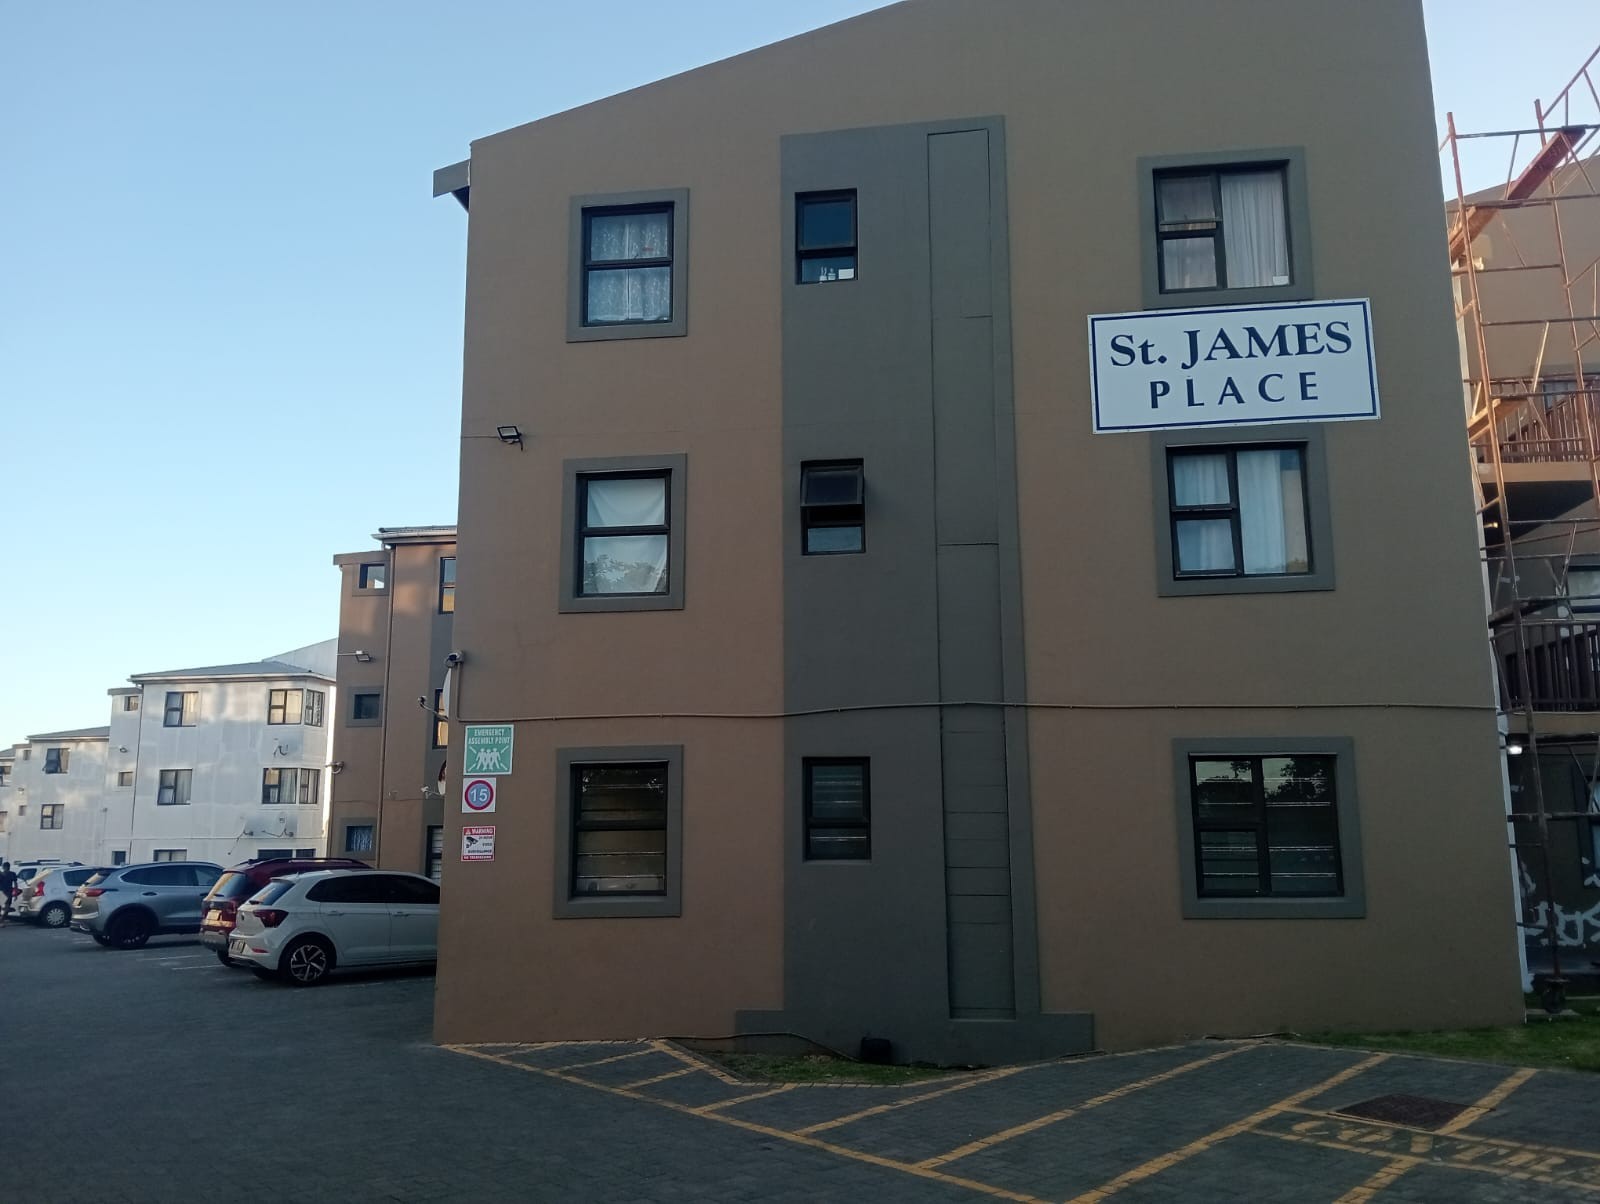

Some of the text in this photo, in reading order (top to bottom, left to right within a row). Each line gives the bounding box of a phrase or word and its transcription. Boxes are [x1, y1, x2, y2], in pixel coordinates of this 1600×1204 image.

[1110, 320, 1352, 370] St. JAMES
[1149, 371, 1319, 409] PLACE
[474, 728, 505, 737] EMERGENCY
[468, 736, 511, 745] ASSEMBLY POINT
[470, 788, 488, 802] 15
